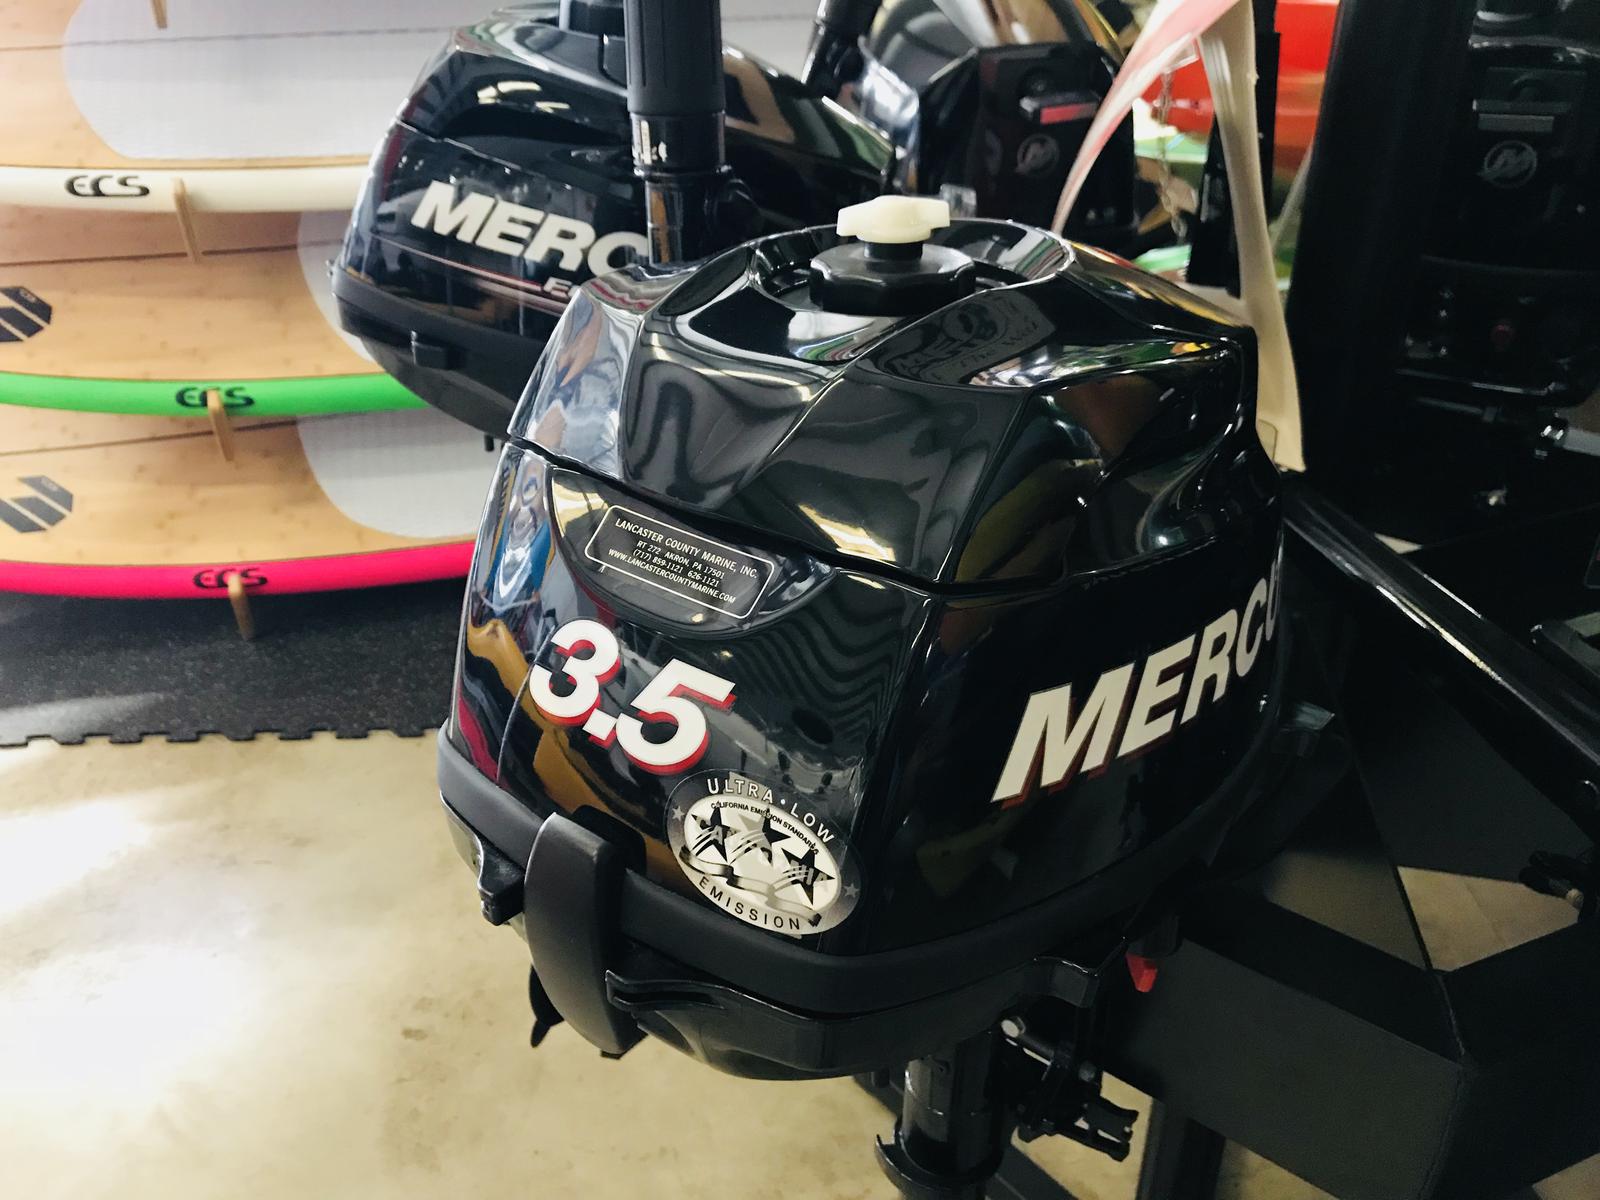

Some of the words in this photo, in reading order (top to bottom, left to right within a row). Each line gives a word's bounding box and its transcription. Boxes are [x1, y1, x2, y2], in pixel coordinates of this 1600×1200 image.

[64, 175, 150, 197] ECS
[608, 548, 736, 604] WWW.LANCASTERCOUNTYMARINE.COM
[615, 518, 664, 544] LANCASTER
[665, 538, 701, 557] COUNTY
[701, 551, 737, 573] MARINE,
[739, 566, 758, 579] INC.
[633, 548, 652, 562] (717)
[652, 556, 683, 573] 859-1121
[687, 570, 719, 587] 626-1121
[636, 540, 647, 549] RT
[647, 544, 661, 555] 272
[664, 551, 689, 568] AKRON,
[691, 561, 702, 571] PA
[703, 566, 725, 580] 17501
[529, 619, 737, 775] 3.5
[707, 778, 774, 805] ULTRA
[790, 802, 835, 844] LOW
[711, 800, 749, 812] CALIFORNIA
[698, 876, 800, 931] EMISSION
